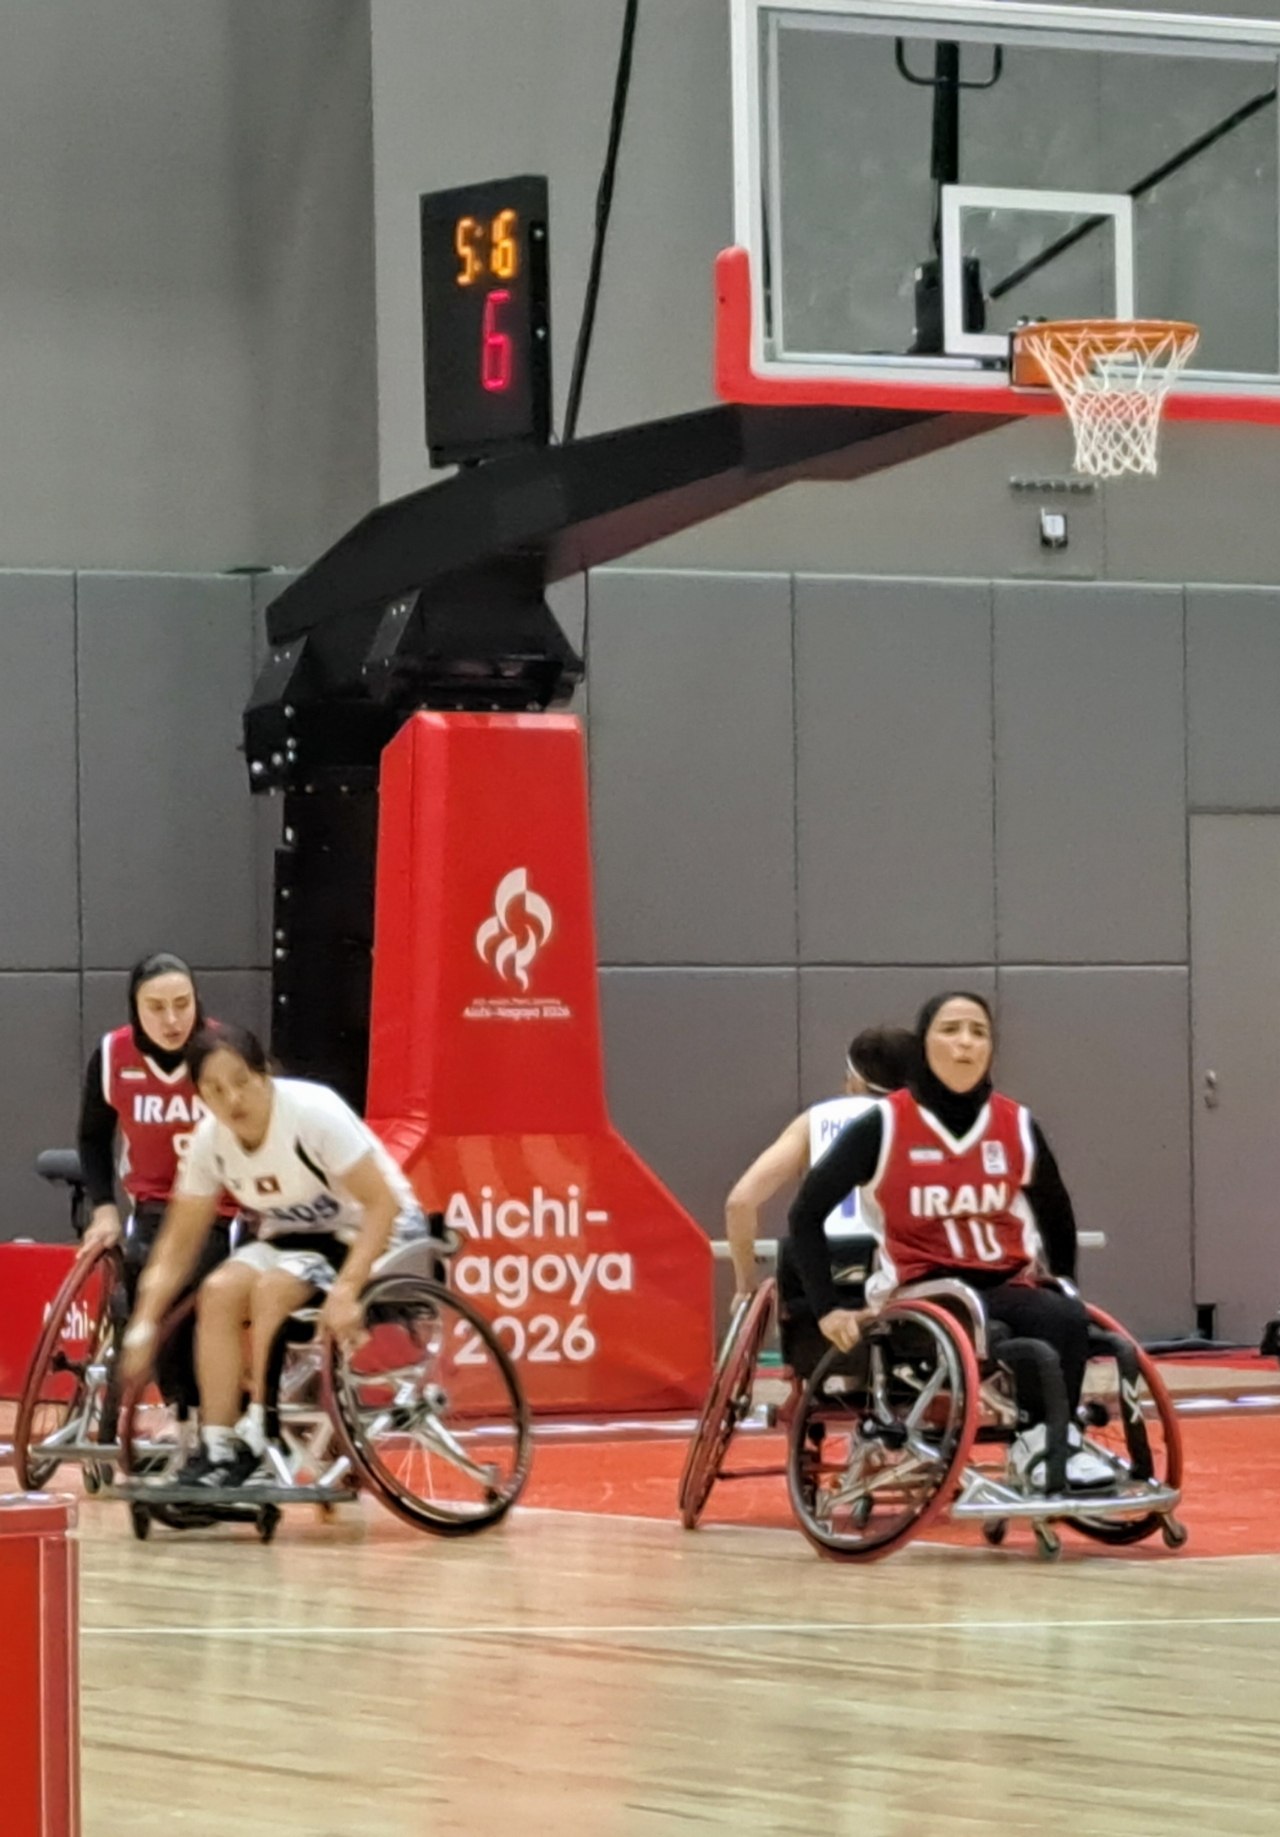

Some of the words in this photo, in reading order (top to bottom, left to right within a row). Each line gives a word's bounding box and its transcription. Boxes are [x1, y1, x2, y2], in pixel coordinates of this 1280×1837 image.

[483, 289, 511, 390] 6
[444, 1184, 609, 1239] Aichi-
[909, 1182, 1008, 1217] IRAN
[446, 1252, 633, 1309] agoya
[452, 1314, 597, 1365] 2026
